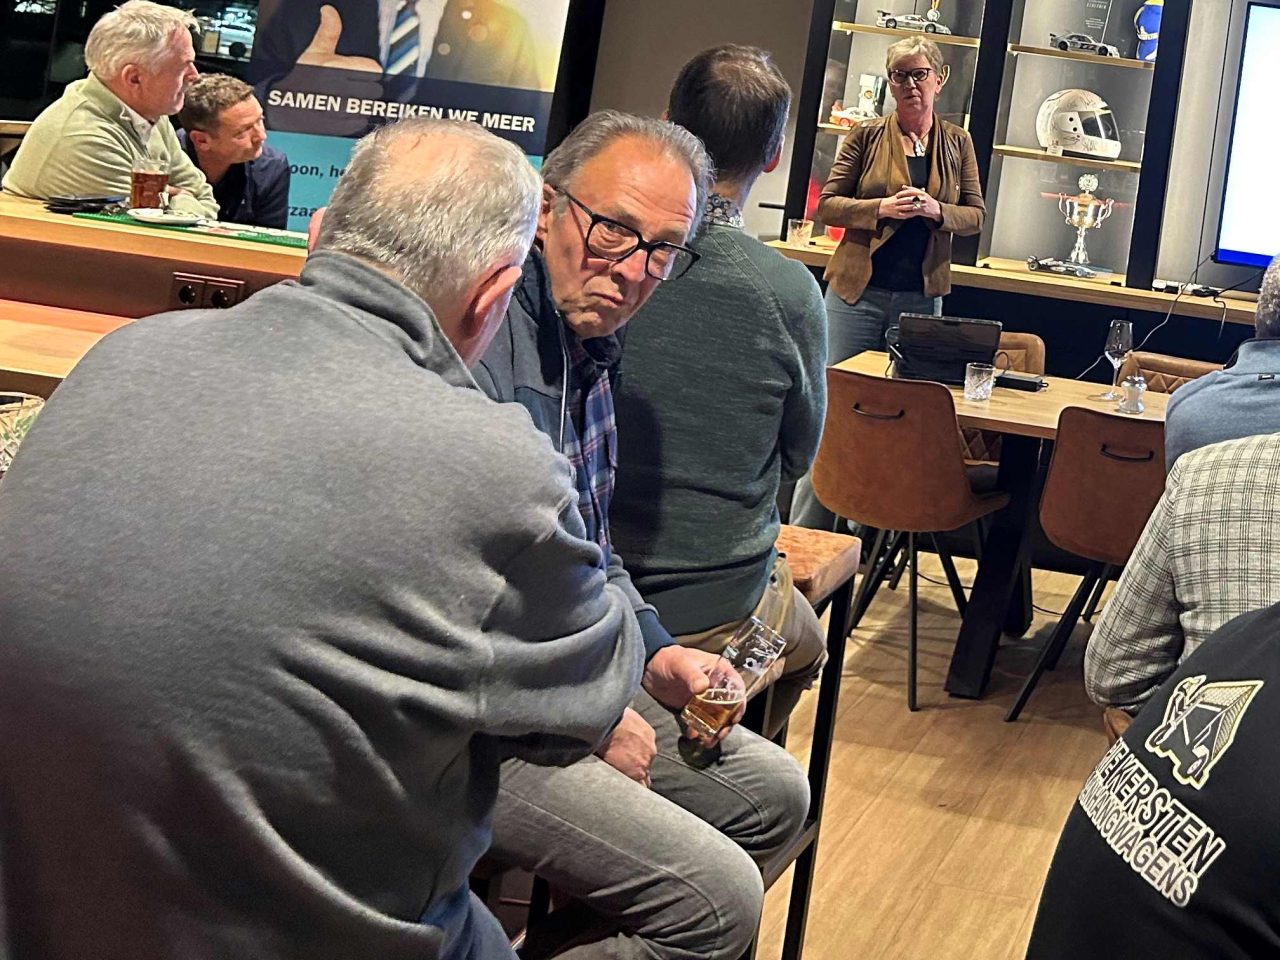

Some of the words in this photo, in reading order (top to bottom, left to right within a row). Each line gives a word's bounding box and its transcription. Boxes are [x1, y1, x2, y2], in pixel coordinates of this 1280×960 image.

[267, 90, 341, 112] SAMEN
[346, 97, 443, 119] BEREIKEN
[448, 108, 479, 122] WE
[482, 113, 536, 133] MEER
[289, 164, 324, 179] oon,
[1079, 771, 1199, 907] ANHANGWAGENS
